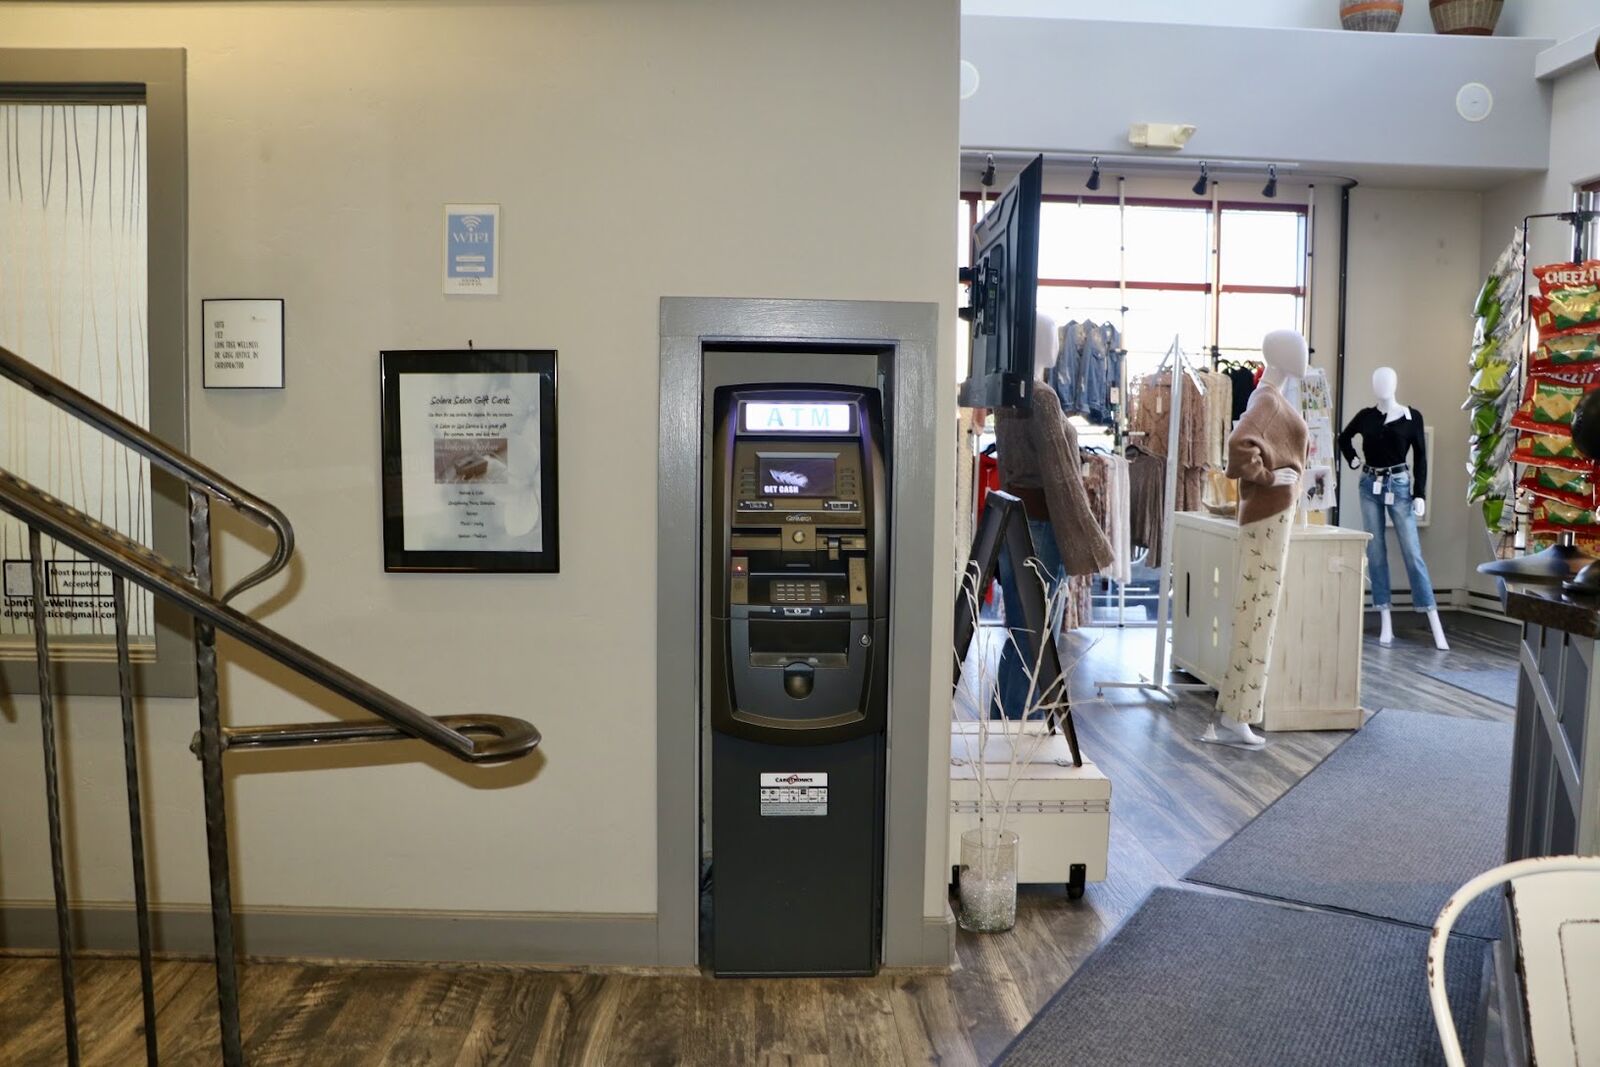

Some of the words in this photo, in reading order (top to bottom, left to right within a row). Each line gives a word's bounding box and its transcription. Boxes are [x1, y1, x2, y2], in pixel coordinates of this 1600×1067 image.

[453, 395, 472, 405] Salon
[474, 394, 489, 406] Gift
[491, 395, 511, 405] Cards
[767, 407, 830, 427] ATM
[764, 485, 777, 493] GET
[779, 485, 799, 494] CASH
[51, 568, 70, 576] Most
[72, 568, 111, 577] Insurances
[63, 580, 99, 588] Accepted
